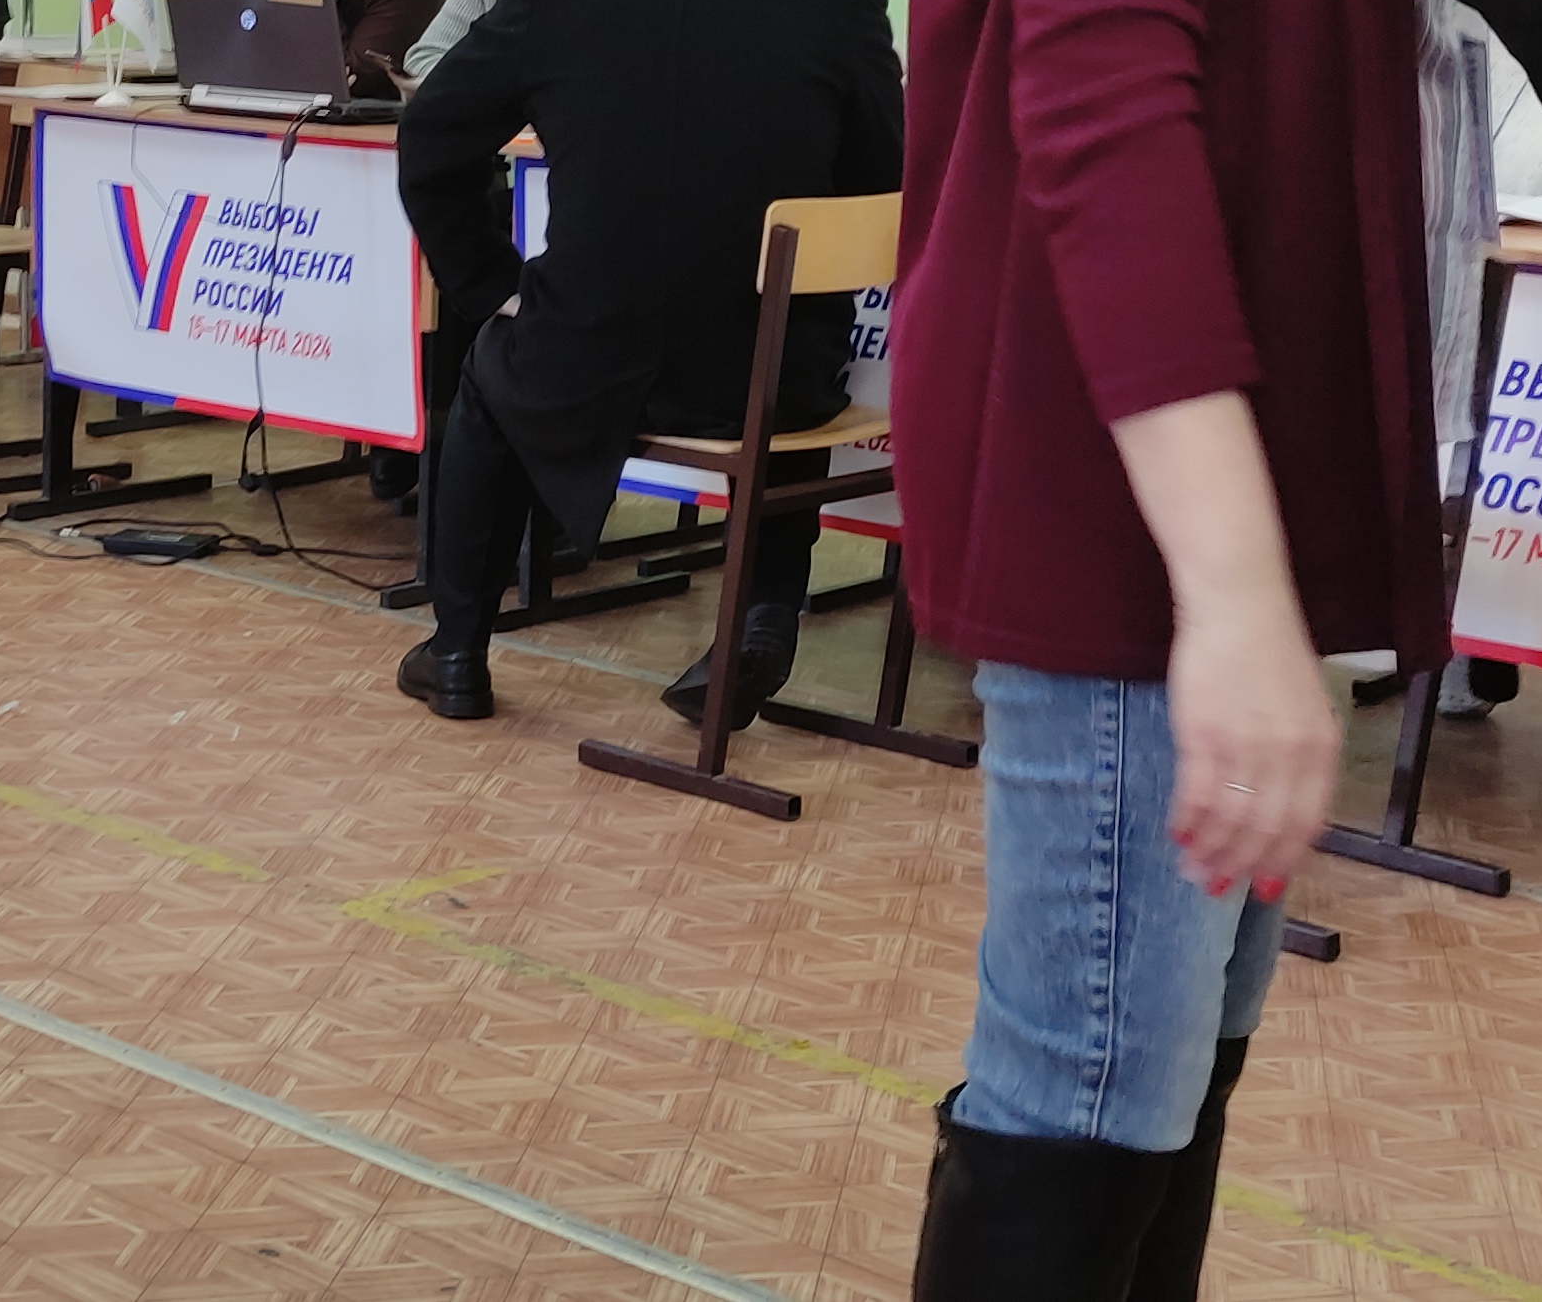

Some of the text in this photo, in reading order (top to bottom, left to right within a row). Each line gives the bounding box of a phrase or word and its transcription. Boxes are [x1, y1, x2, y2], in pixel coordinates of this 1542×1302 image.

[218, 198, 321, 238] ВЫБОРЫ
[202, 238, 354, 286] ПРЕЗИДЕНТА
[192, 278, 285, 317] РОССИИ
[232, 322, 288, 353] МАРТА
[290, 331, 332, 362] 2024
[1471, 527, 1523, 560] –17
